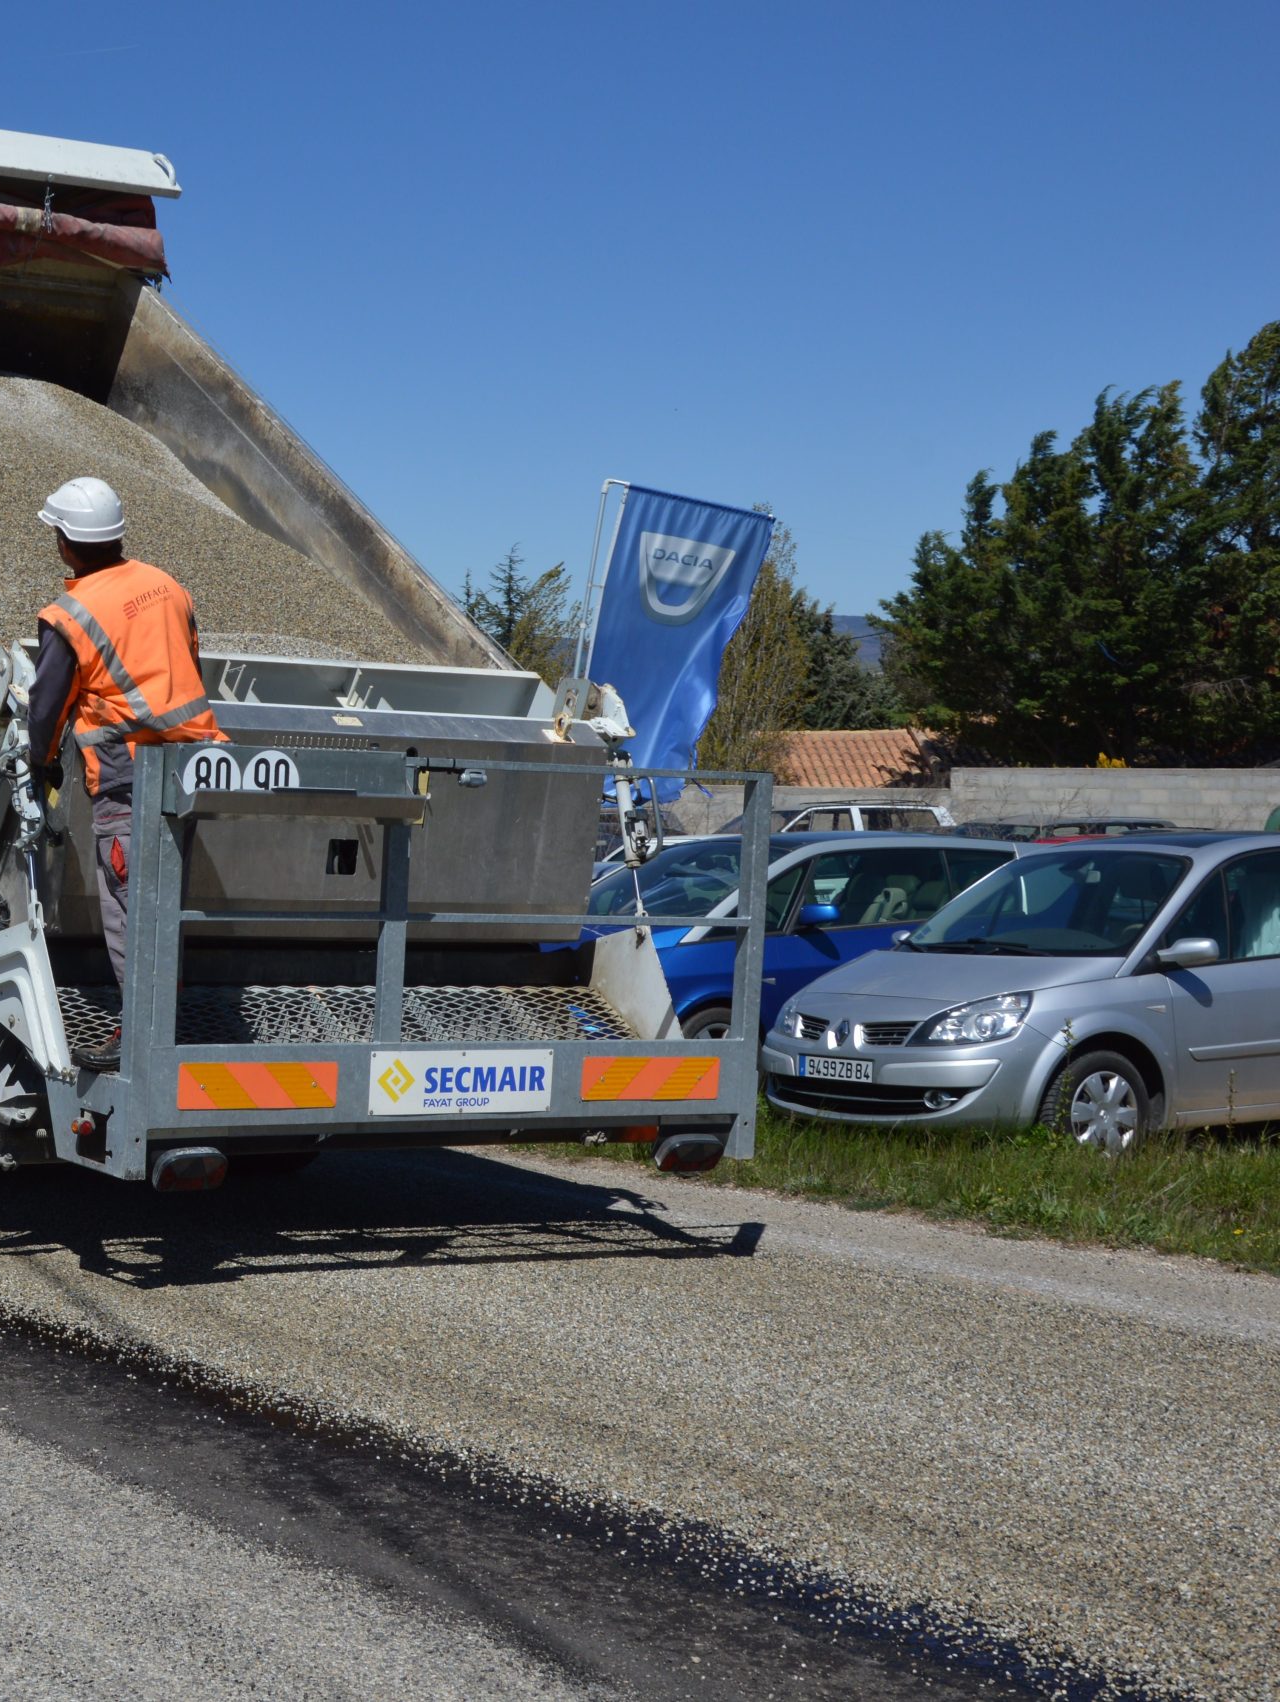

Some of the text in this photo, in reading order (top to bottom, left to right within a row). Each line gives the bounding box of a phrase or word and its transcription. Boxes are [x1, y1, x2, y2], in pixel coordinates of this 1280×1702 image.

[652, 548, 713, 571] DACIA
[135, 584, 171, 606] EIFFAGE
[195, 756, 231, 791] 80
[254, 757, 290, 790] 90
[424, 1065, 546, 1094] SECMAIR
[423, 1097, 490, 1108] FAYAT GROUP
